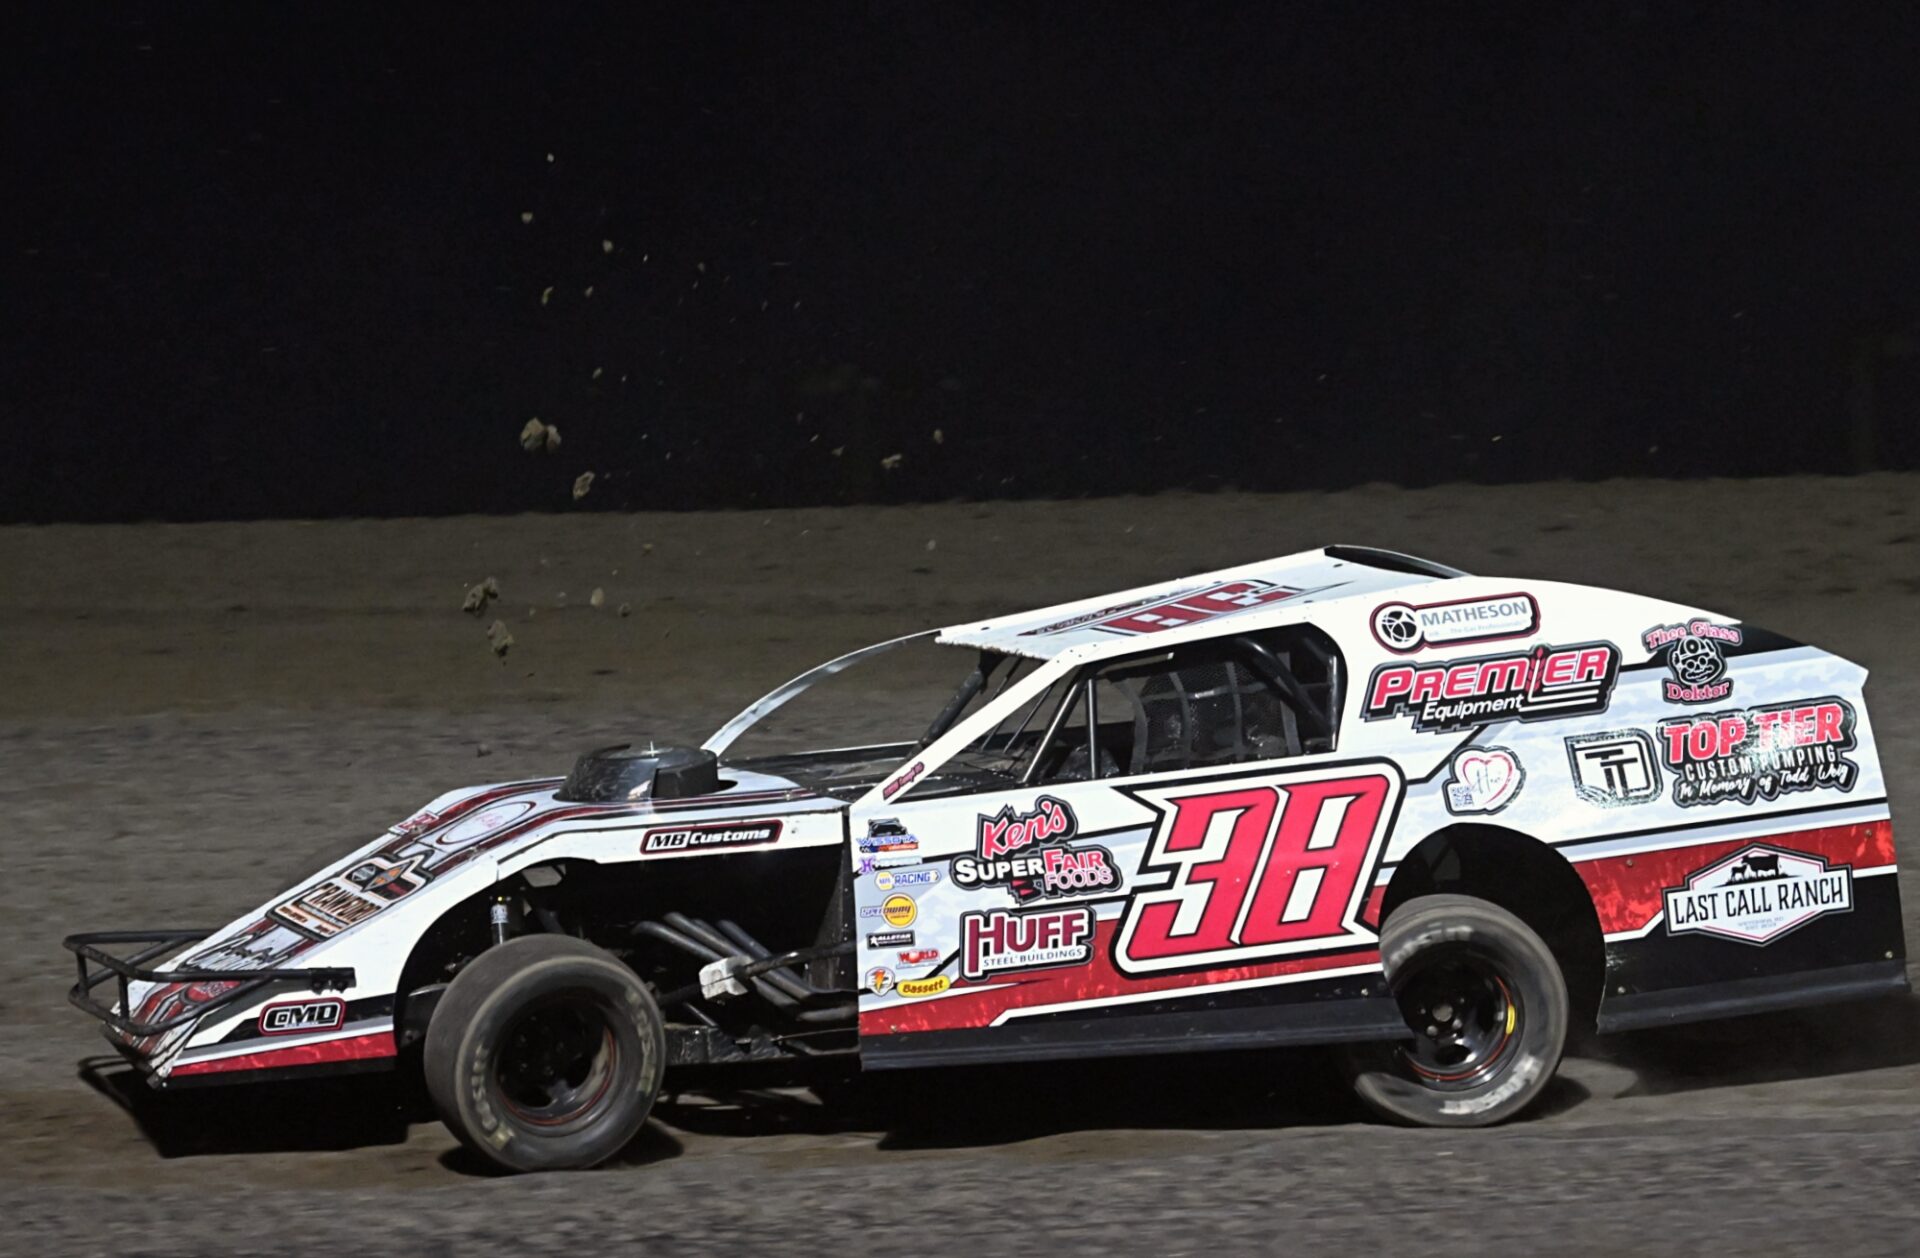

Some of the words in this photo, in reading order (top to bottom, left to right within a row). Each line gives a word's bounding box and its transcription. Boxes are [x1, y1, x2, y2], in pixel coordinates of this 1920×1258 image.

[1421, 601, 1528, 627] MATHESON
[1690, 621, 1739, 643] Glass
[1370, 646, 1610, 710] PREMIER
[1666, 682, 1729, 701] Doktor
[1422, 694, 1524, 722] Equipment
[1663, 718, 1747, 764] TOP
[1755, 703, 1844, 752] TIER
[1685, 755, 1753, 782] CUSTOM
[1760, 745, 1837, 772] PUMPING
[1698, 776, 1751, 798] Memory
[1758, 774, 1773, 792] of
[1780, 768, 1809, 787] Todd
[651, 833, 687, 849] MB
[690, 829, 771, 845] Customs
[983, 800, 1067, 859] Ken's
[894, 872, 930, 886] RACING
[1045, 867, 1113, 890] FOODS
[1126, 774, 1390, 961] 38
[1673, 892, 1719, 925] LAST
[1726, 886, 1772, 918] CALL
[1778, 876, 1844, 911] RANCH
[968, 912, 1085, 973] HUFF
[983, 955, 1015, 967] STEEL
[1020, 948, 1083, 963] BUILDINGS
[902, 979, 944, 994] Bassett
